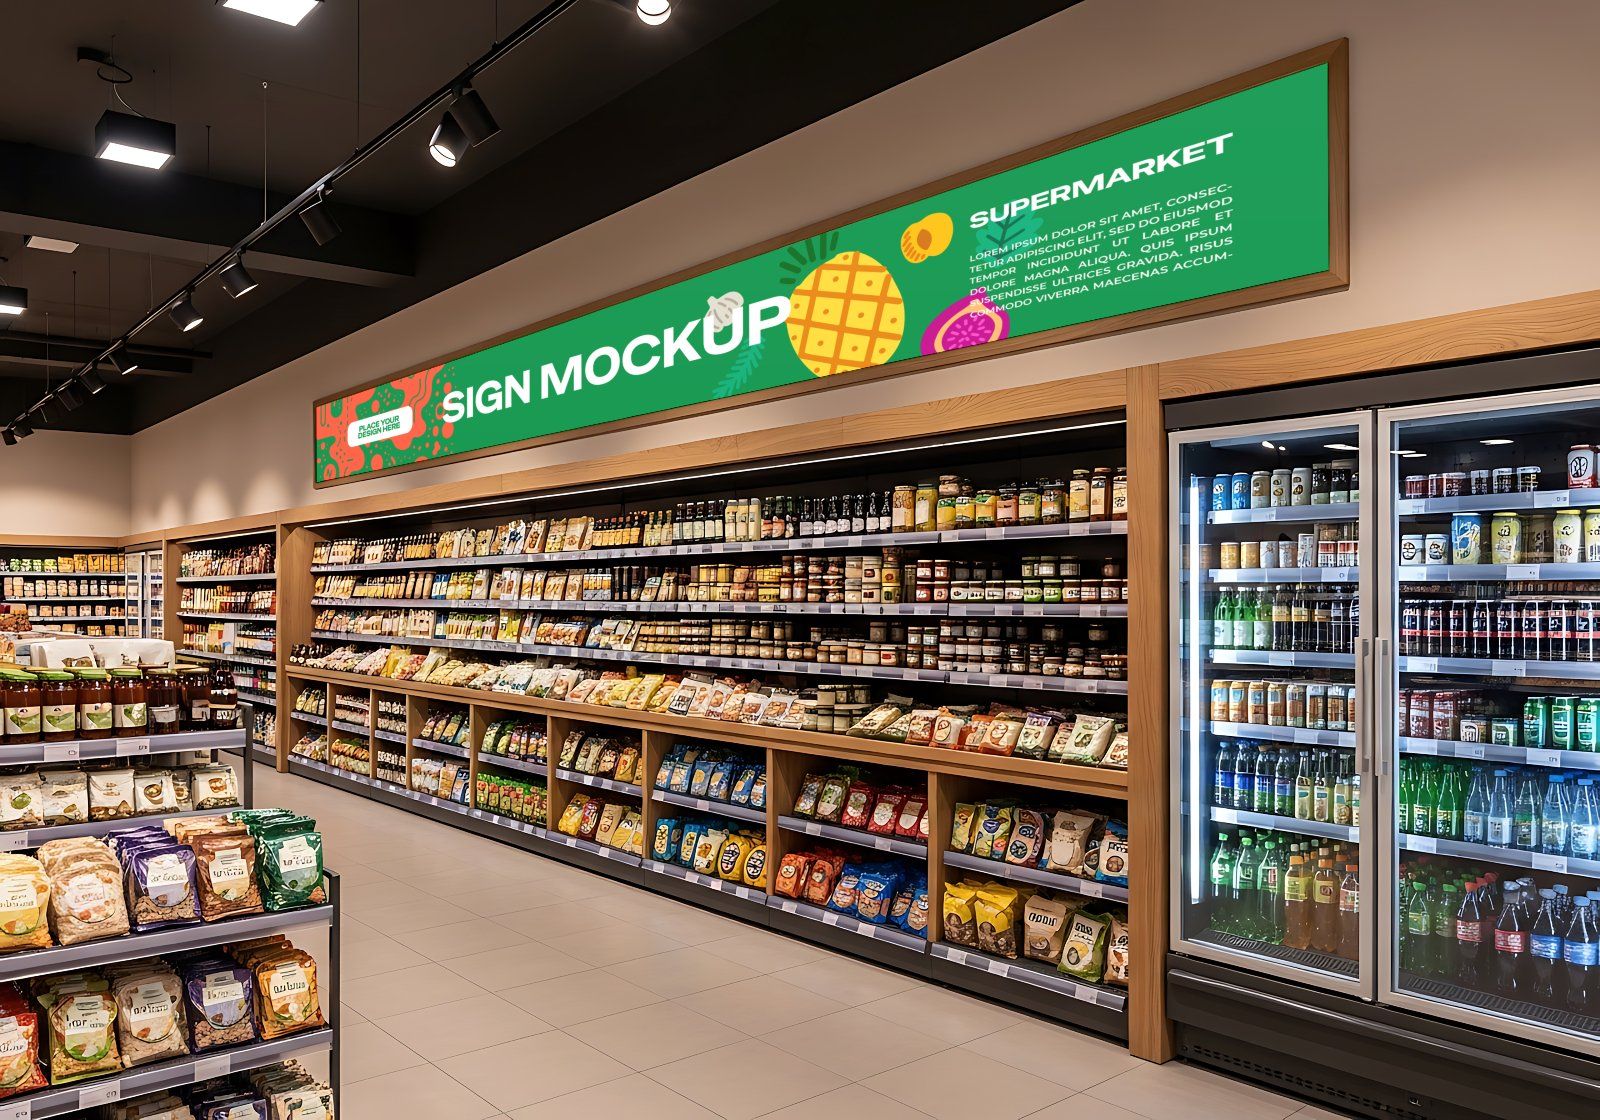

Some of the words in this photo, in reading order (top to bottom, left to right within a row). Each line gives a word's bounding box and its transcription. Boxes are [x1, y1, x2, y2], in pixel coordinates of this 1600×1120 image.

[970, 132, 1233, 228] SUPERMARKET
[970, 246, 1008, 262] LOREM
[1012, 235, 1048, 251] IPSUM
[1052, 221, 1096, 239] DOLOR
[1099, 214, 1119, 227] SIT
[1122, 203, 1163, 221] AMET,
[1167, 183, 1232, 207] CONSEC-
[970, 258, 1004, 273] TETUR
[1007, 240, 1075, 263] ADIPISCING
[1078, 231, 1106, 244] ELIT,
[1109, 221, 1135, 236] SED
[1139, 215, 1160, 229] DO
[1164, 196, 1233, 221] EIUSMOD
[970, 267, 1016, 284] TEMPOR
[1028, 245, 1099, 269] INCIDIDUNT
[1112, 237, 1129, 248] UT
[1142, 218, 1200, 239] LABORE
[1215, 210, 1234, 221] ET
[970, 278, 1016, 296] DOLORE
[1025, 266, 1069, 282] MAGNA
[1079, 250, 1131, 268] ALIQUA.
[1141, 238, 1175, 253] QUIS
[1185, 223, 1232, 243] IPSUM
[970, 282, 1046, 306] SUSPENDISSE
[1052, 267, 1111, 288] ULTRICES
[1117, 251, 1183, 271] GRAVIDA.
[1190, 237, 1233, 253] RISUS
[970, 297, 1032, 318] COMMODO
[1036, 285, 1089, 302] VIVERRA
[1093, 267, 1169, 289] MAECENAS
[1173, 253, 1233, 271] ACCUM-
[442, 369, 532, 424] SIGN
[541, 295, 792, 400] MOCKUP
[358, 428, 382, 439] DESIGN
[383, 422, 400, 432] HERE
[359, 421, 380, 432] PLACE
[381, 416, 399, 425] YOUR
